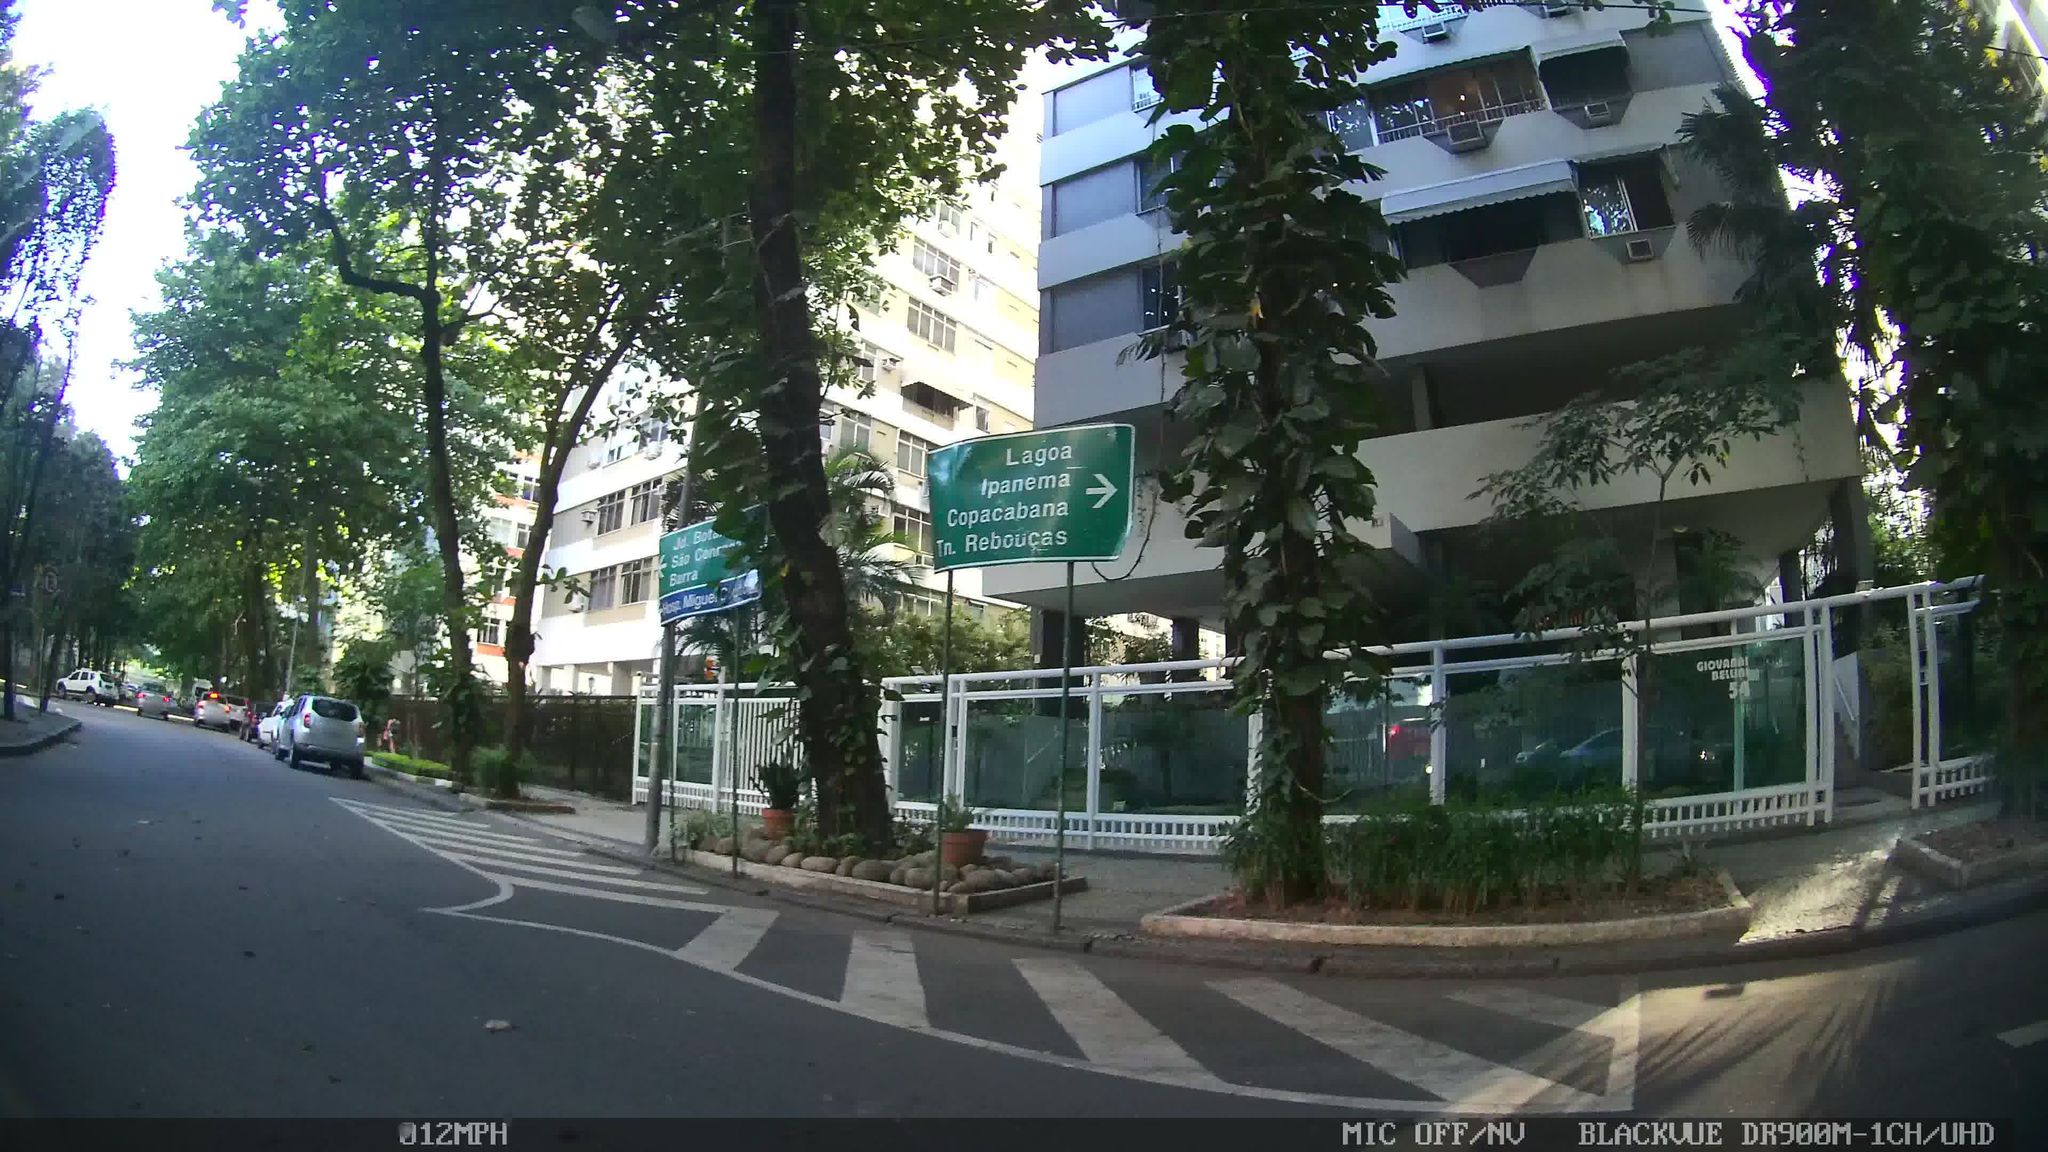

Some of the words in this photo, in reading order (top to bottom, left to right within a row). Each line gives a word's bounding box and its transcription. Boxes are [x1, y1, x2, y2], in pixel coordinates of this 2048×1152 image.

[1006, 445, 1072, 467] Lagoa
[980, 472, 1071, 499] Ipanema
[947, 501, 1069, 529] Copacabana
[935, 539, 956, 557] Tn.
[965, 529, 1068, 554] Rebouças
[671, 553, 691, 568] São
[669, 570, 698, 587] Barra
[1696, 656, 1749, 672] GIOVANNI
[1728, 681, 1750, 699] 54
